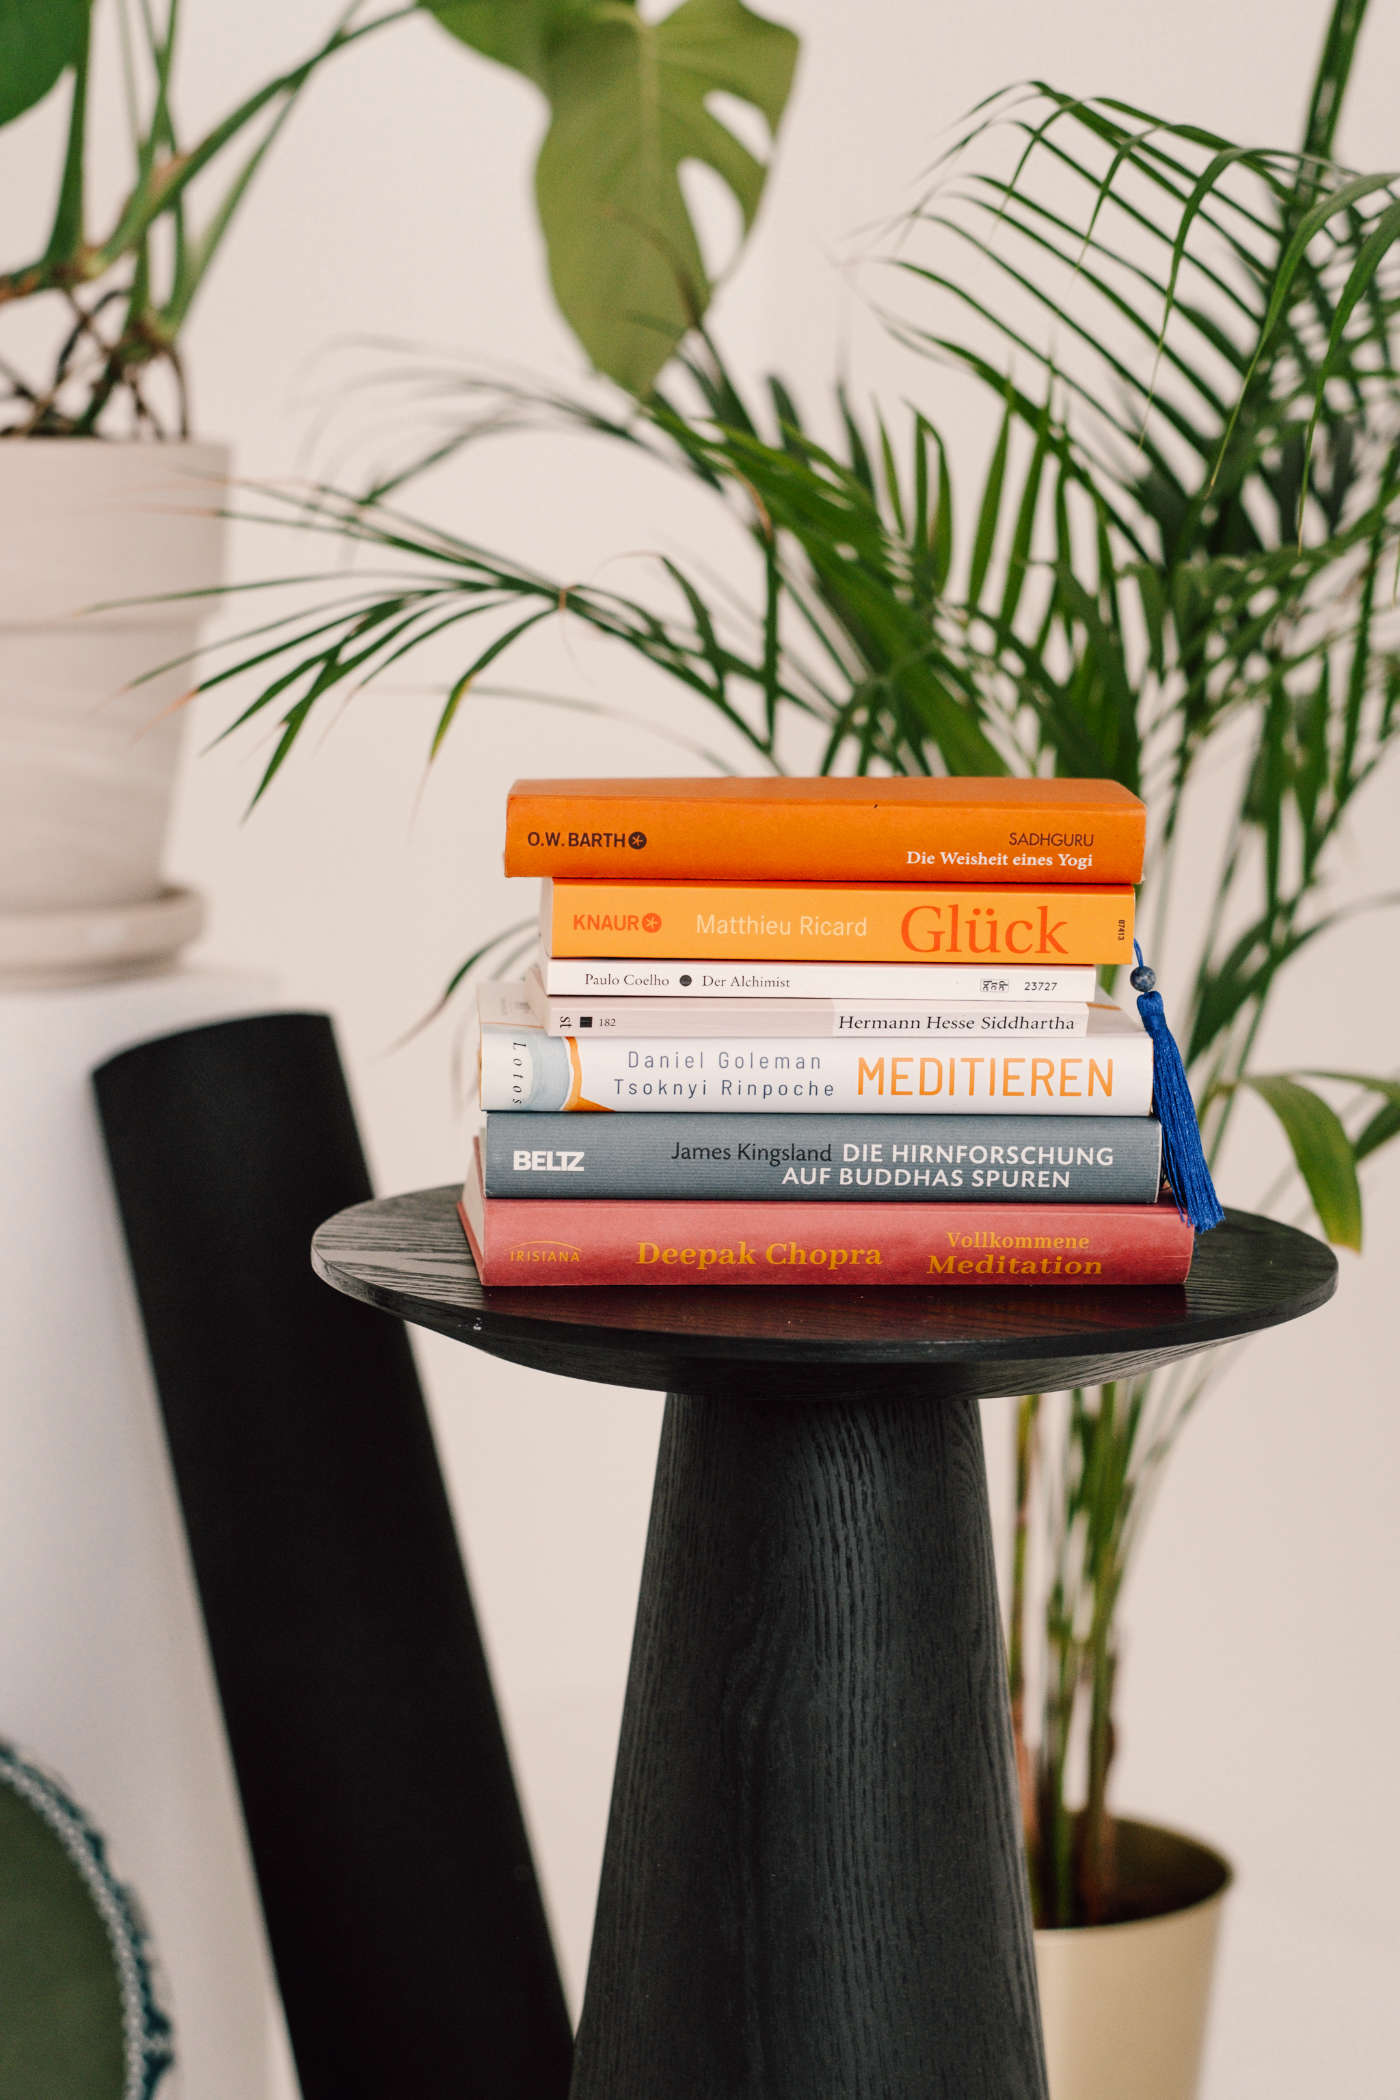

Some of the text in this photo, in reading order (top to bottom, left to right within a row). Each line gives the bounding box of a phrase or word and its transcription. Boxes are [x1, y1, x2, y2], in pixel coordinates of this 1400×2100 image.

[527, 832, 626, 849] O.W. BARTH
[1008, 832, 1095, 848] SADHGURU
[906, 851, 1094, 869] Die Weisheit eines Yogi
[572, 914, 639, 931] KNAUR
[696, 913, 868, 937] Matthieu Ricard
[900, 903, 1070, 955] Glück
[584, 973, 670, 987] Paulo Coelho
[702, 975, 791, 989] Der Alchimist
[1023, 981, 1059, 992] 23727
[599, 1018, 617, 1028] 182
[838, 1014, 1075, 1031] Hermann Hesse Siddhartha
[627, 1050, 823, 1070] Daniel Goleman
[512, 1041, 528, 1105] Lotos
[856, 1056, 1114, 1098] MEDITIEREN
[614, 1078, 835, 1099] Tsoknyi Rinpoche
[513, 1150, 586, 1172] BELTZ
[670, 1142, 1114, 1167] James Kingsland DIE HIRNFORSCHUNG
[781, 1167, 1071, 1188] AUF BUDDHAS SPUREN
[946, 1231, 1090, 1250] Vollkommene
[509, 1250, 581, 1263] IRISIANA
[635, 1240, 883, 1271] Deepak Chopra
[926, 1254, 1103, 1276] Meditation
